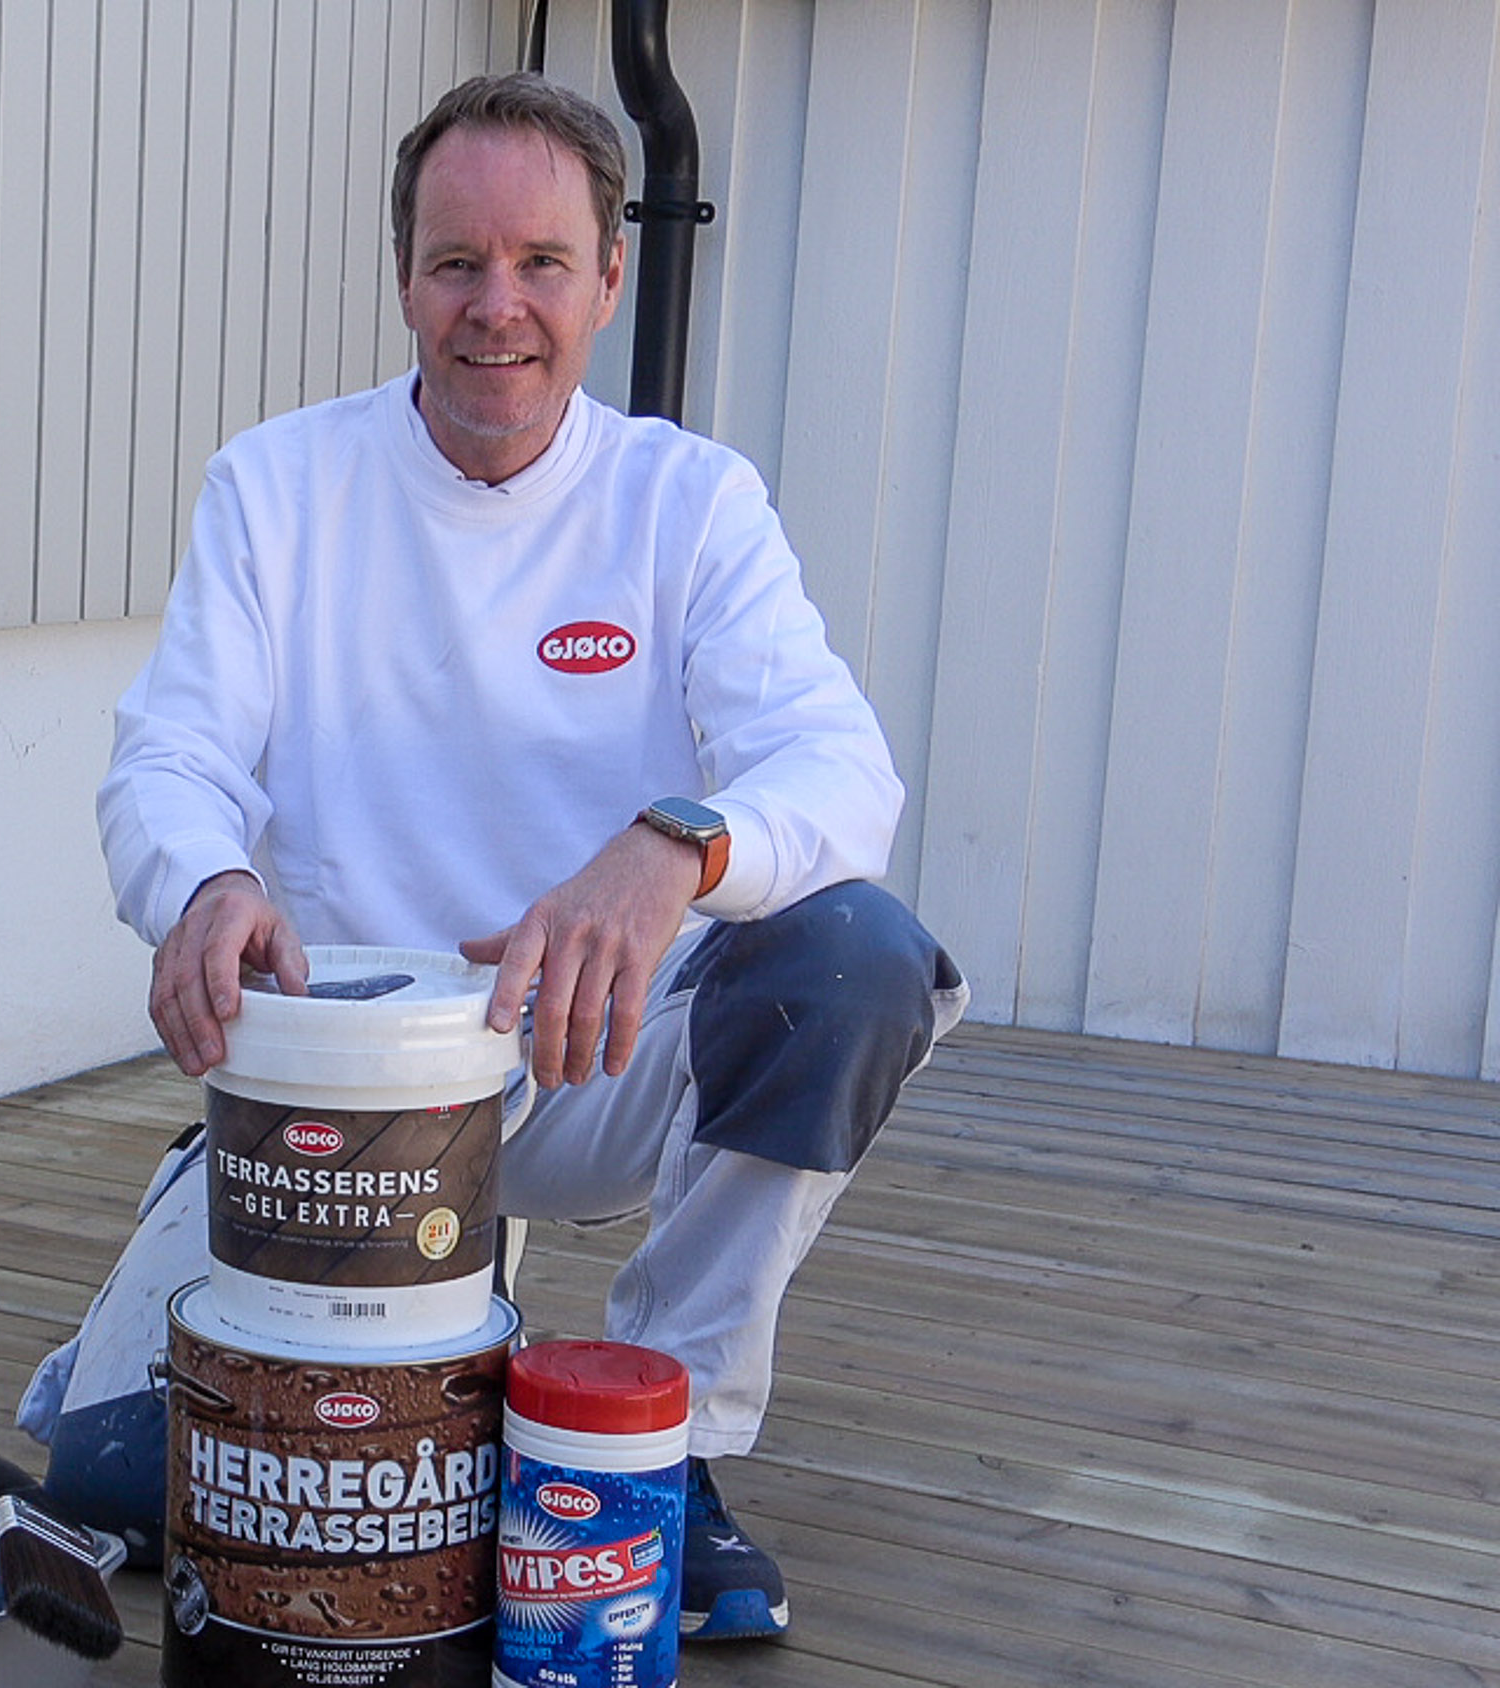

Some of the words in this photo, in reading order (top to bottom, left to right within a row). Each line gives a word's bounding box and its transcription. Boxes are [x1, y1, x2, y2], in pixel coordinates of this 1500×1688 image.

[543, 635, 631, 660] GJØCO
[217, 1148, 439, 1196] TERRASSERENS
[245, 1193, 286, 1220] GEL
[298, 1202, 391, 1227] EXTRA
[320, 1402, 374, 1417] GJØCO
[191, 1428, 497, 1509] HERREGÅRD
[540, 1490, 596, 1512] GJØCO
[190, 1481, 496, 1553] TERRASSEBEIS
[290, 1658, 320, 1671] LANG
[306, 1673, 376, 1685] OLJEBASERT
